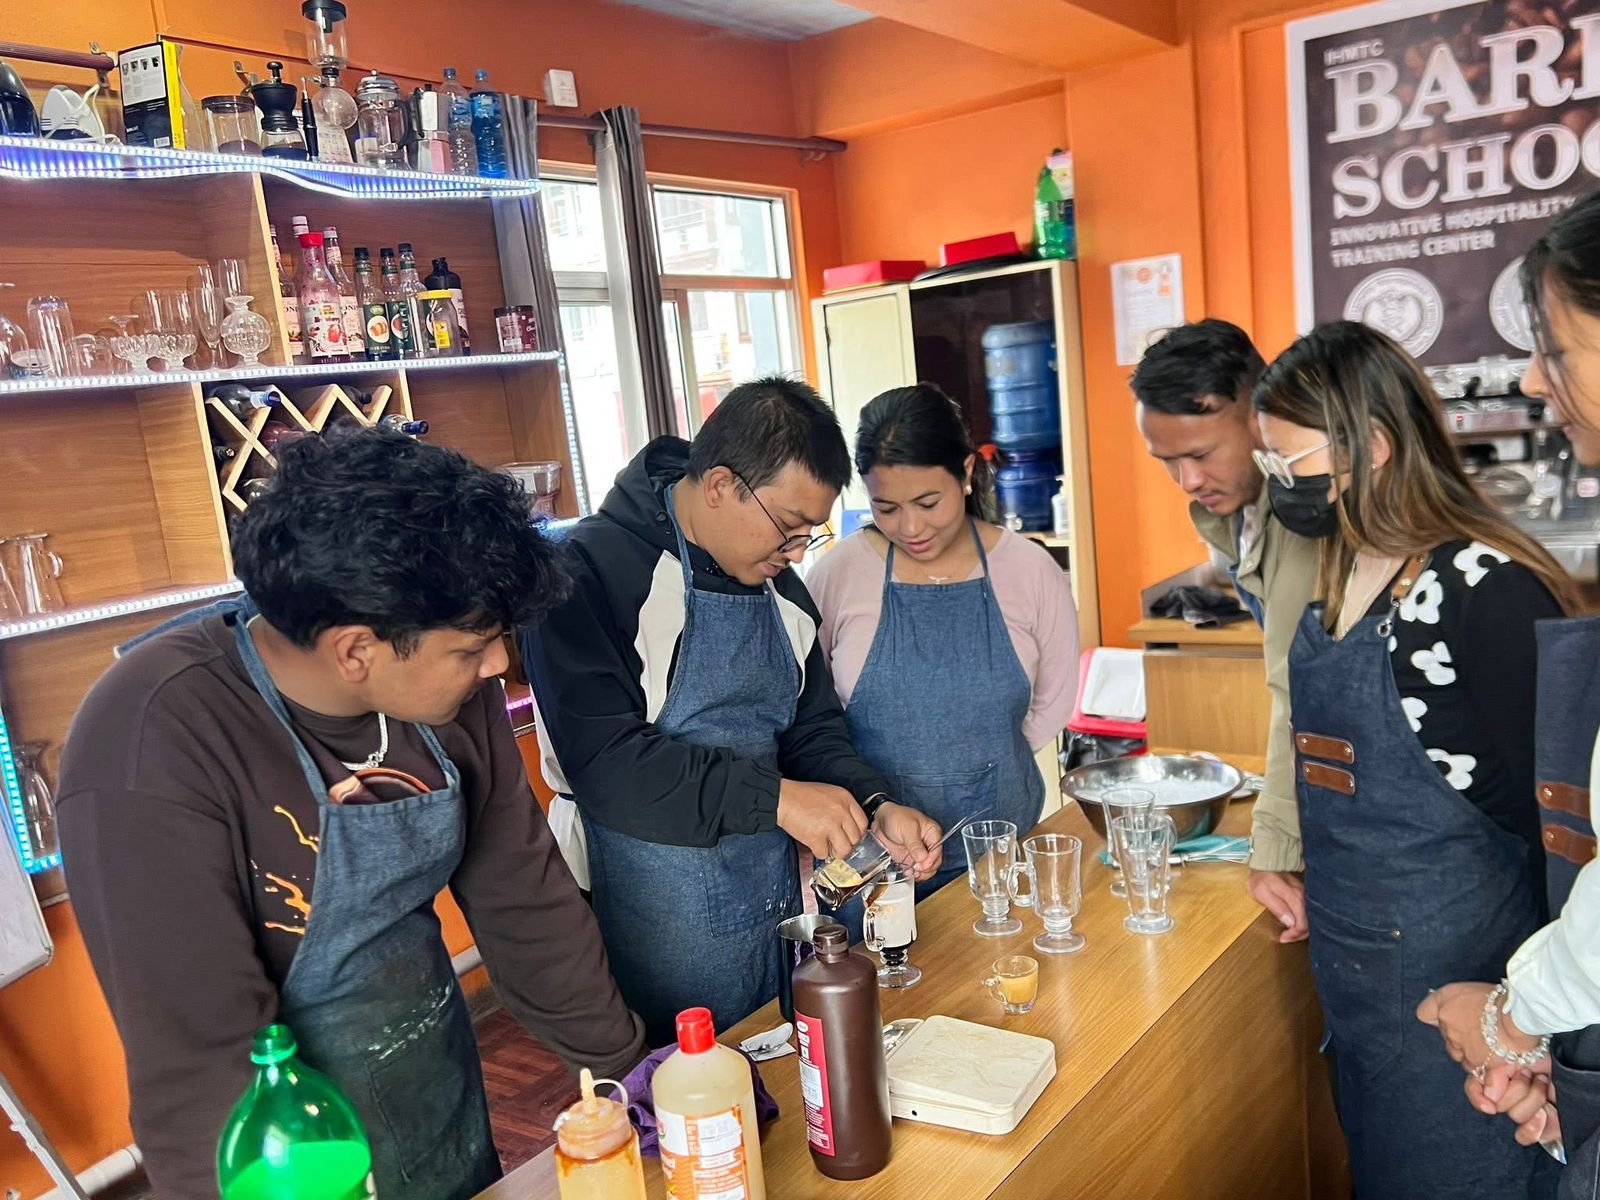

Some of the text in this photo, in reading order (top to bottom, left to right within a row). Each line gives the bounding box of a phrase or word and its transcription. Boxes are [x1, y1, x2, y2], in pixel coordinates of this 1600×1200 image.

[1332, 118, 1600, 220] SCHO
[1330, 196, 1577, 247] INNOVATIVE HOSPITALITY
[1330, 230, 1496, 268] TRAINING CENTER
